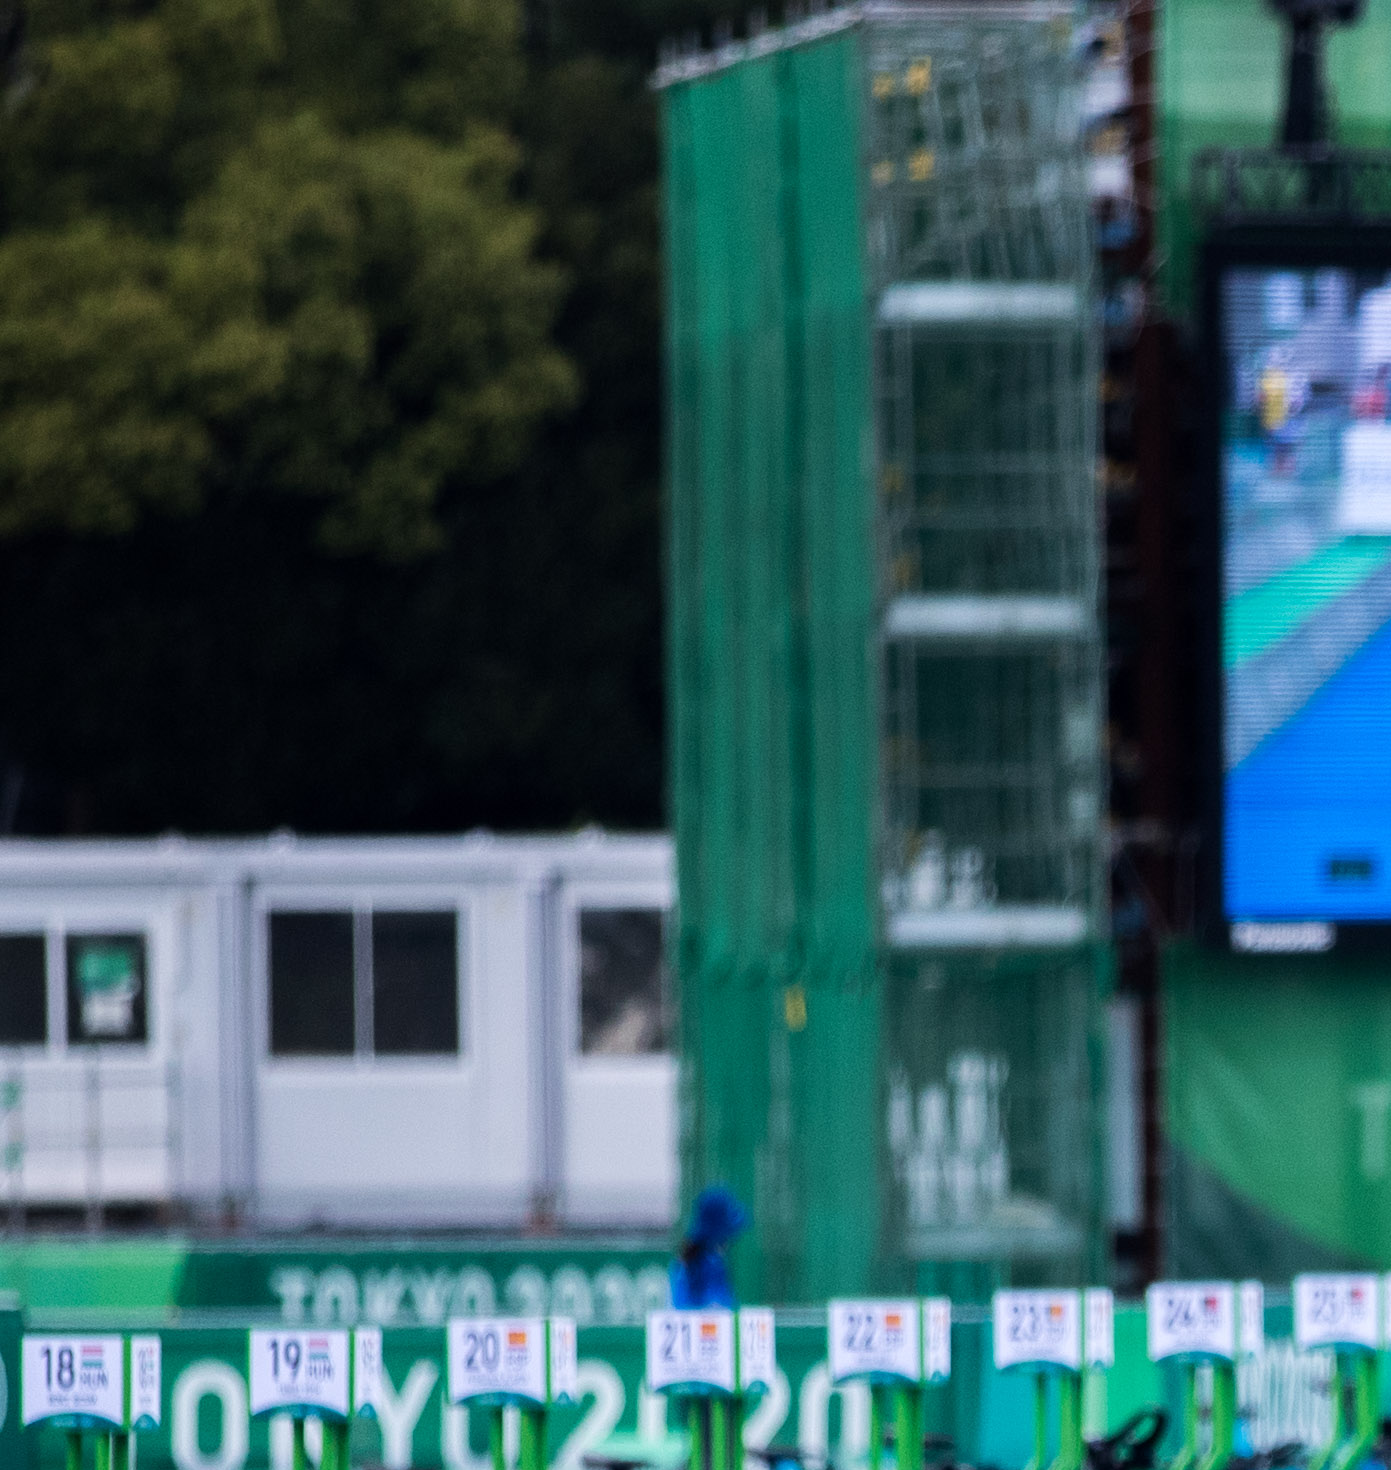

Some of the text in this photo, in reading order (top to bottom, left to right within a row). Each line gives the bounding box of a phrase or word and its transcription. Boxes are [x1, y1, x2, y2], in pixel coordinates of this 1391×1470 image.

[42, 1347, 75, 1390] 18
[270, 1338, 301, 1381] 19
[463, 1331, 499, 1374] 20
